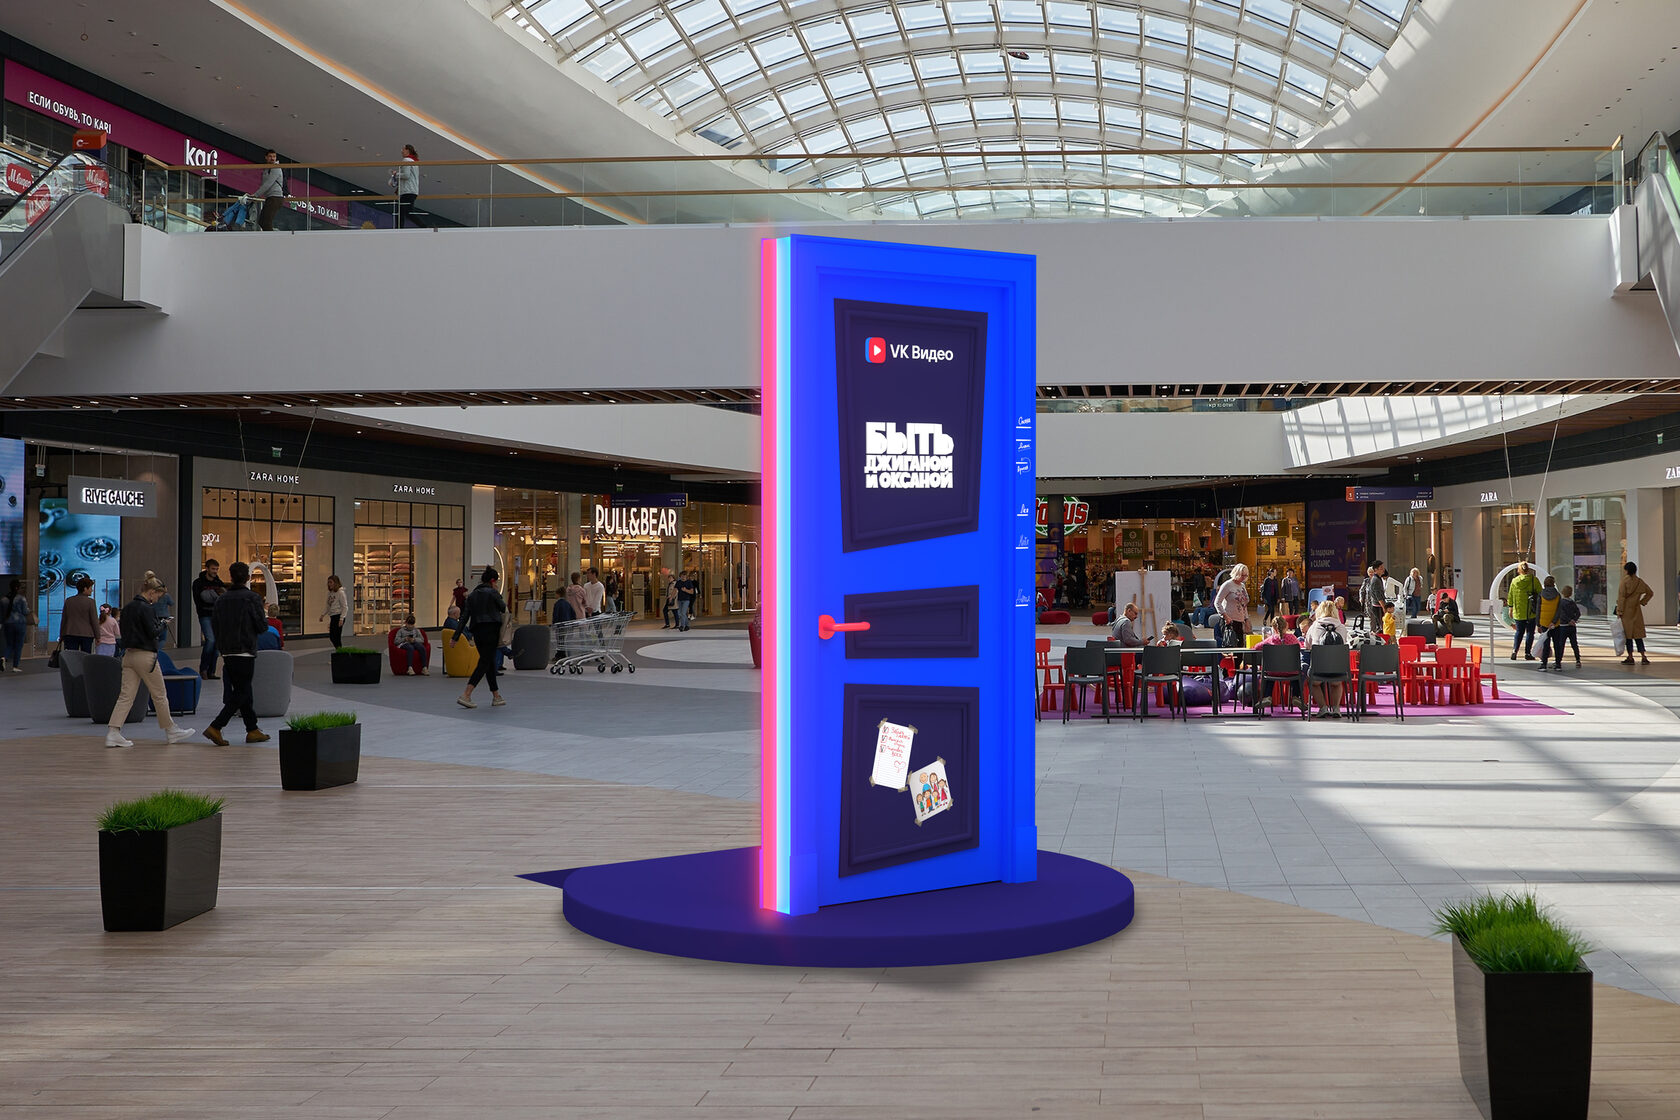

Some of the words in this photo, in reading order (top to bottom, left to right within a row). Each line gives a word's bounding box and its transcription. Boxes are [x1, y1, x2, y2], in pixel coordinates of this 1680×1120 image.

[29, 91, 51, 110] ЕСЛИ
[52, 101, 80, 124] ОБУВЬ,
[81, 112, 93, 126] ТО
[93, 117, 112, 134] KARI
[184, 138, 218, 176] kari
[889, 343, 910, 359] VK
[911, 344, 954, 363] Видео
[865, 421, 955, 455] БЫТЬ
[863, 455, 954, 474] ДЖИГАНОМ
[250, 471, 273, 482] ZARA
[276, 474, 300, 485] HOME
[865, 473, 879, 489] И
[878, 469, 954, 489] ОКСАНОЙ
[82, 487, 107, 505] RIVE
[107, 489, 145, 507] GAUCHE
[393, 484, 413, 493] ZARA
[415, 486, 436, 496] HOME
[1480, 491, 1498, 502] ZARA
[1410, 499, 1428, 509] ZARA
[595, 504, 677, 537] PULL&BEAR
